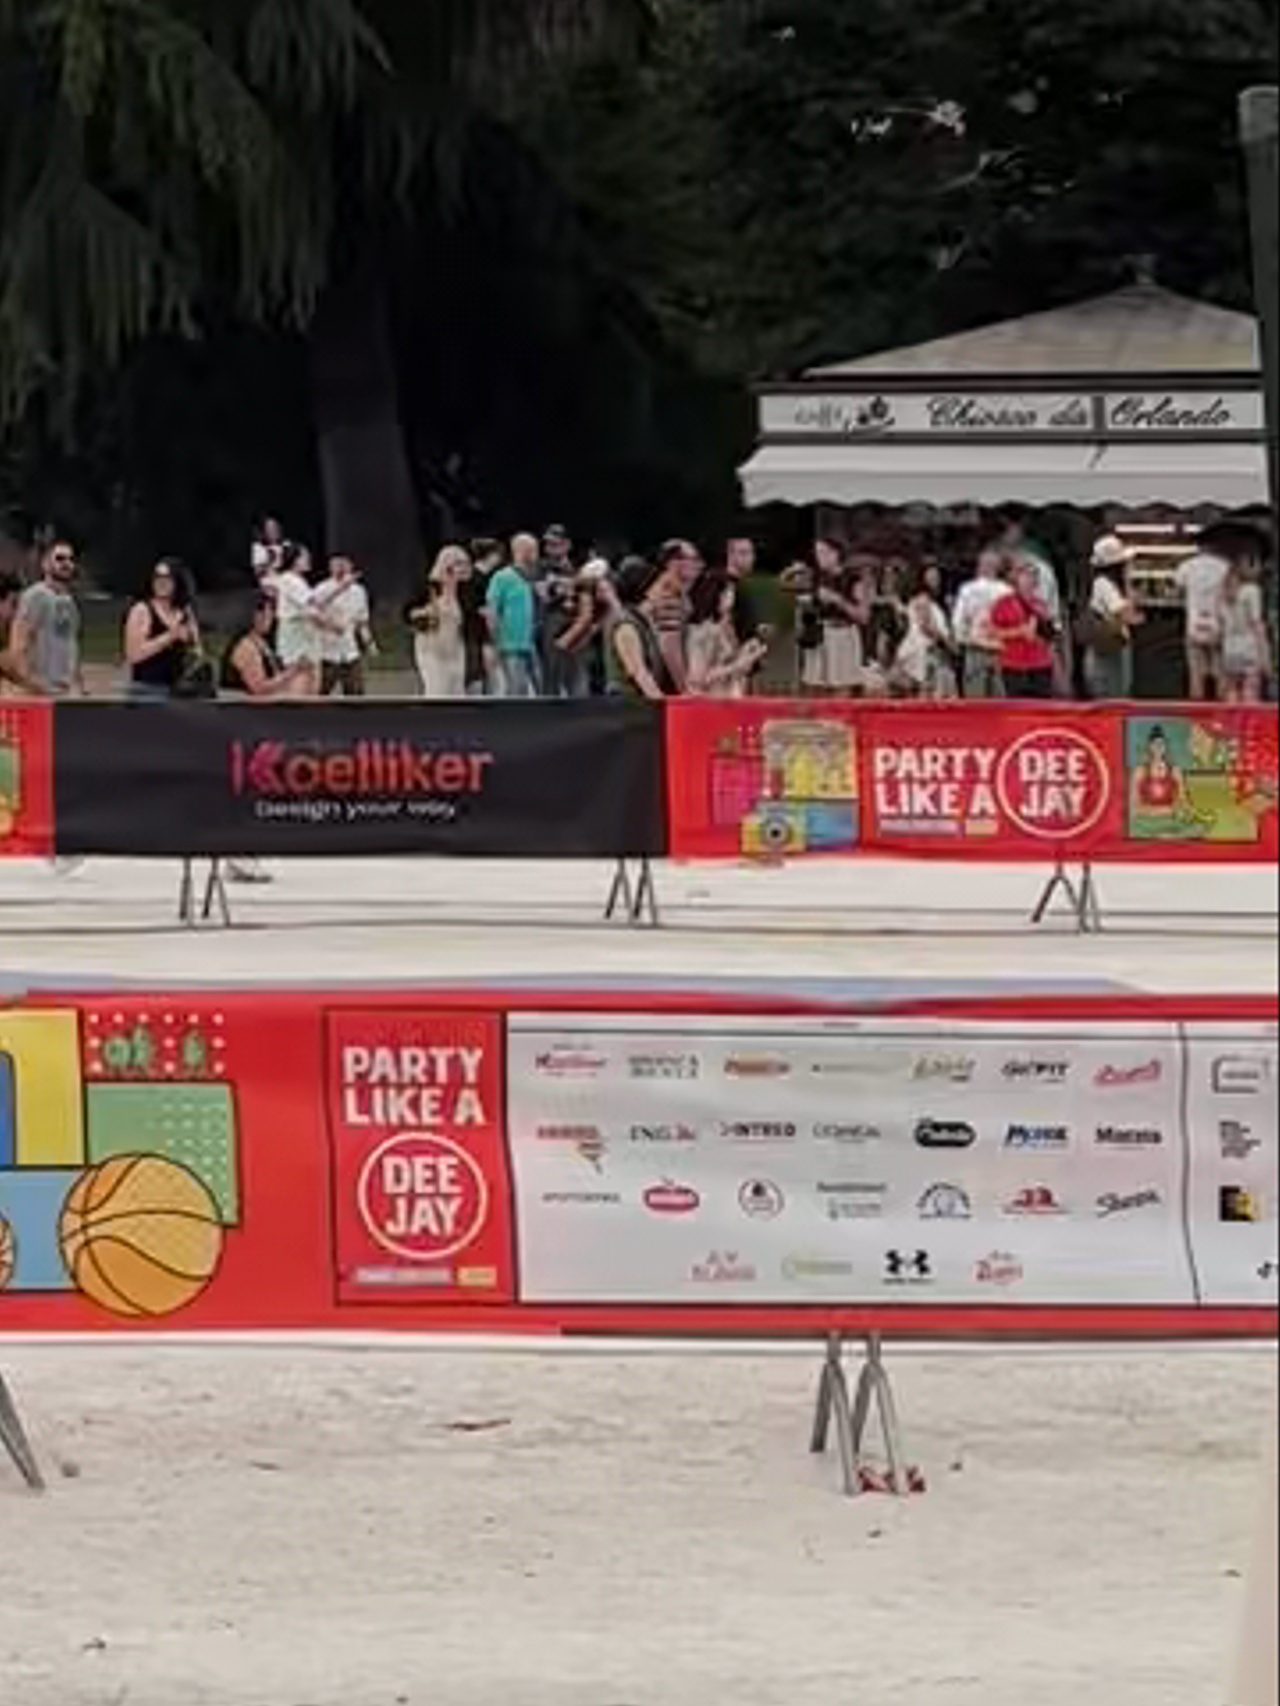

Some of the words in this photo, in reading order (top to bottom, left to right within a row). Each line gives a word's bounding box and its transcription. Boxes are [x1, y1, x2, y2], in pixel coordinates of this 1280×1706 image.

[875, 747, 996, 779] PARTY
[1018, 748, 1088, 781] DEE
[876, 782, 961, 815] LIKE
[970, 782, 997, 815] A
[1019, 785, 1088, 817] JAY
[342, 1046, 484, 1084] PARTY
[345, 1087, 446, 1126] LIKE
[453, 1087, 487, 1126] A
[382, 1155, 463, 1195] DEE
[384, 1197, 463, 1238] JAY
